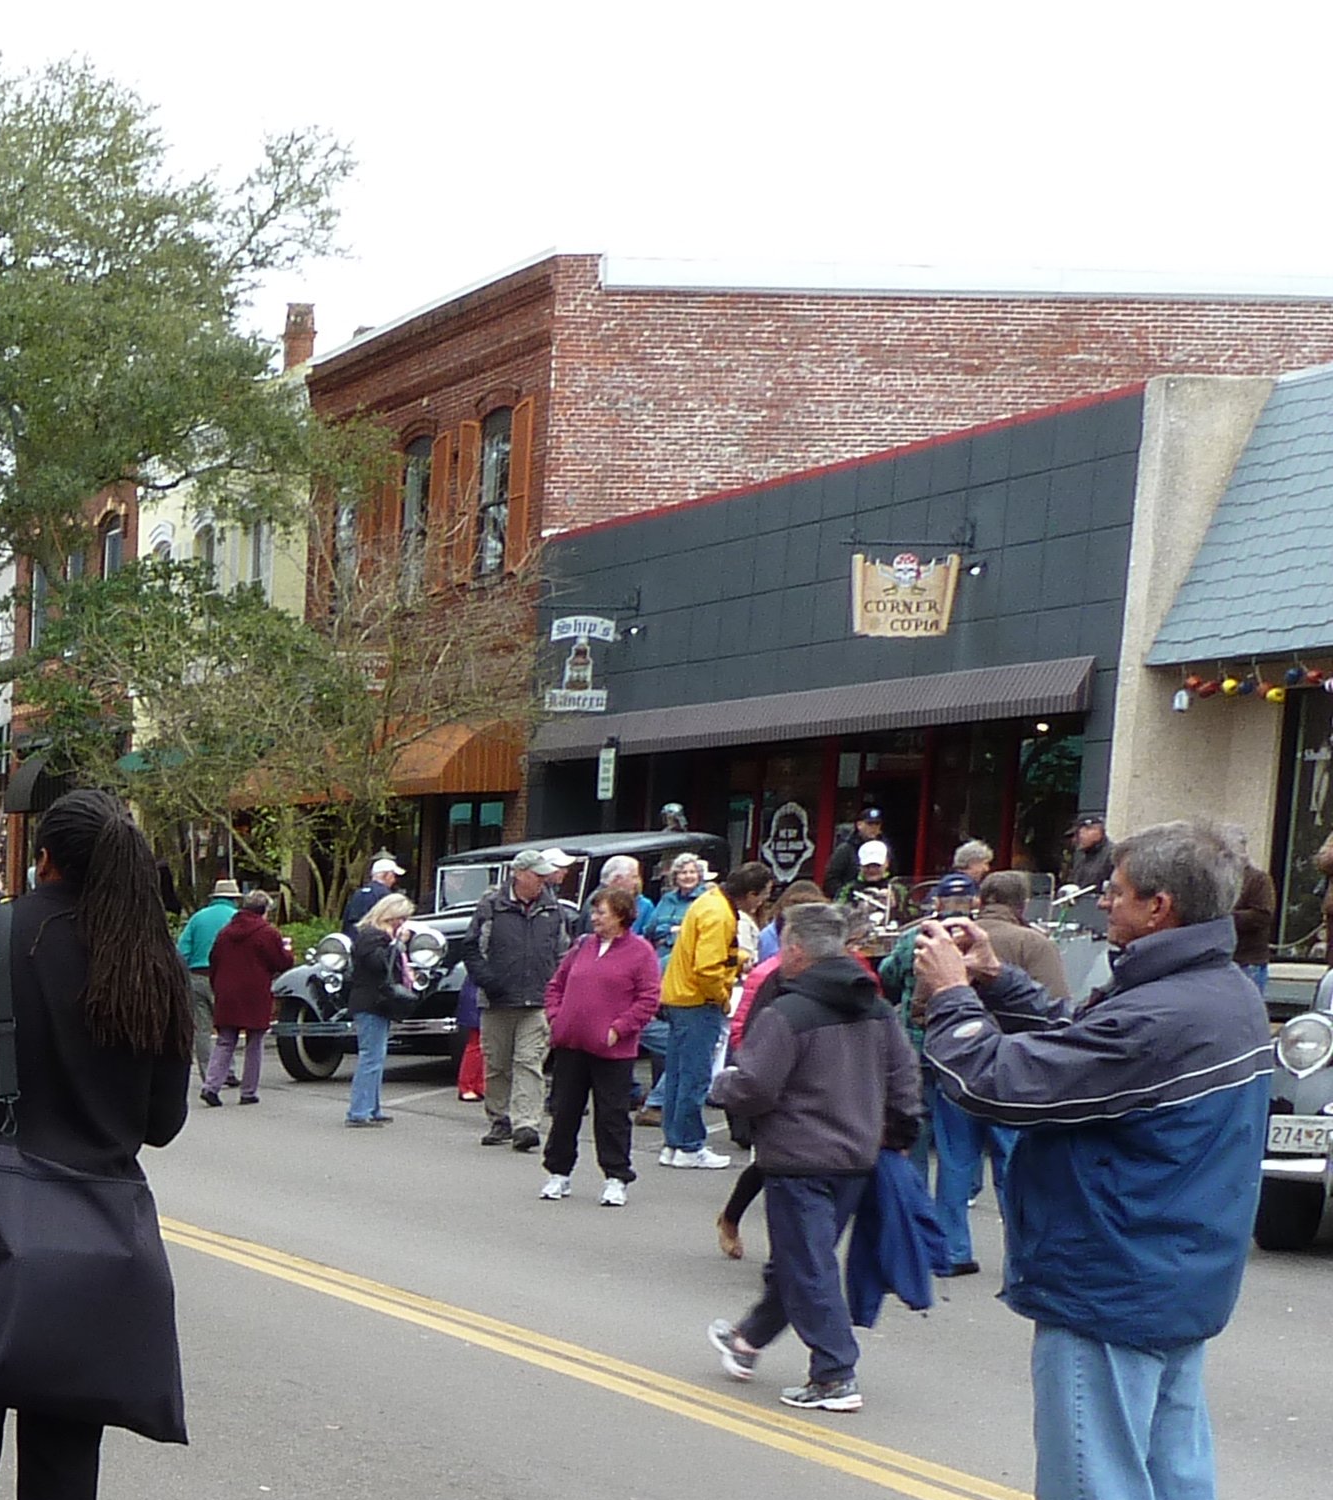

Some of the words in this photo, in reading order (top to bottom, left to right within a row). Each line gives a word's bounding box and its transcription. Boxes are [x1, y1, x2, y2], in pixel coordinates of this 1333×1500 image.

[864, 599, 942, 615] CORNER
[556, 618, 611, 637] Ship's
[890, 618, 939, 632] COPIA
[1272, 1126, 1303, 1144] 274
